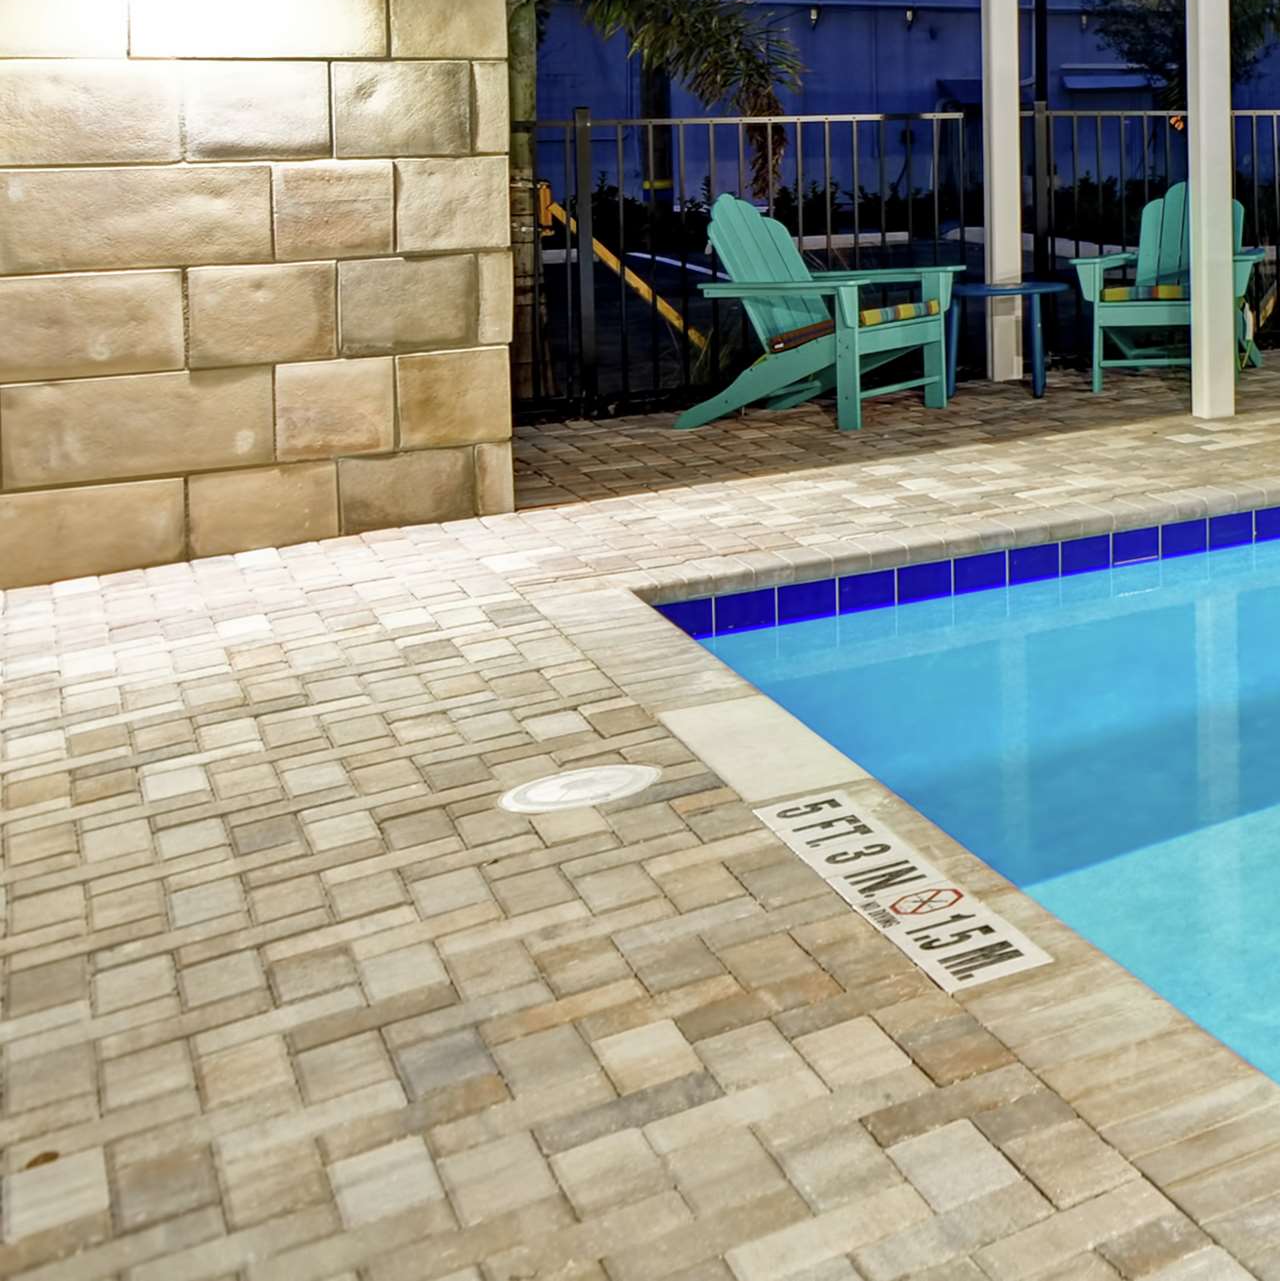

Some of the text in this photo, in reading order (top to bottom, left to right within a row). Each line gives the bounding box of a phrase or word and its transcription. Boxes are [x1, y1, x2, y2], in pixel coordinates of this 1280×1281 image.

[775, 798, 1024, 981] 5 FT. 3 IN. 1.5 M.
